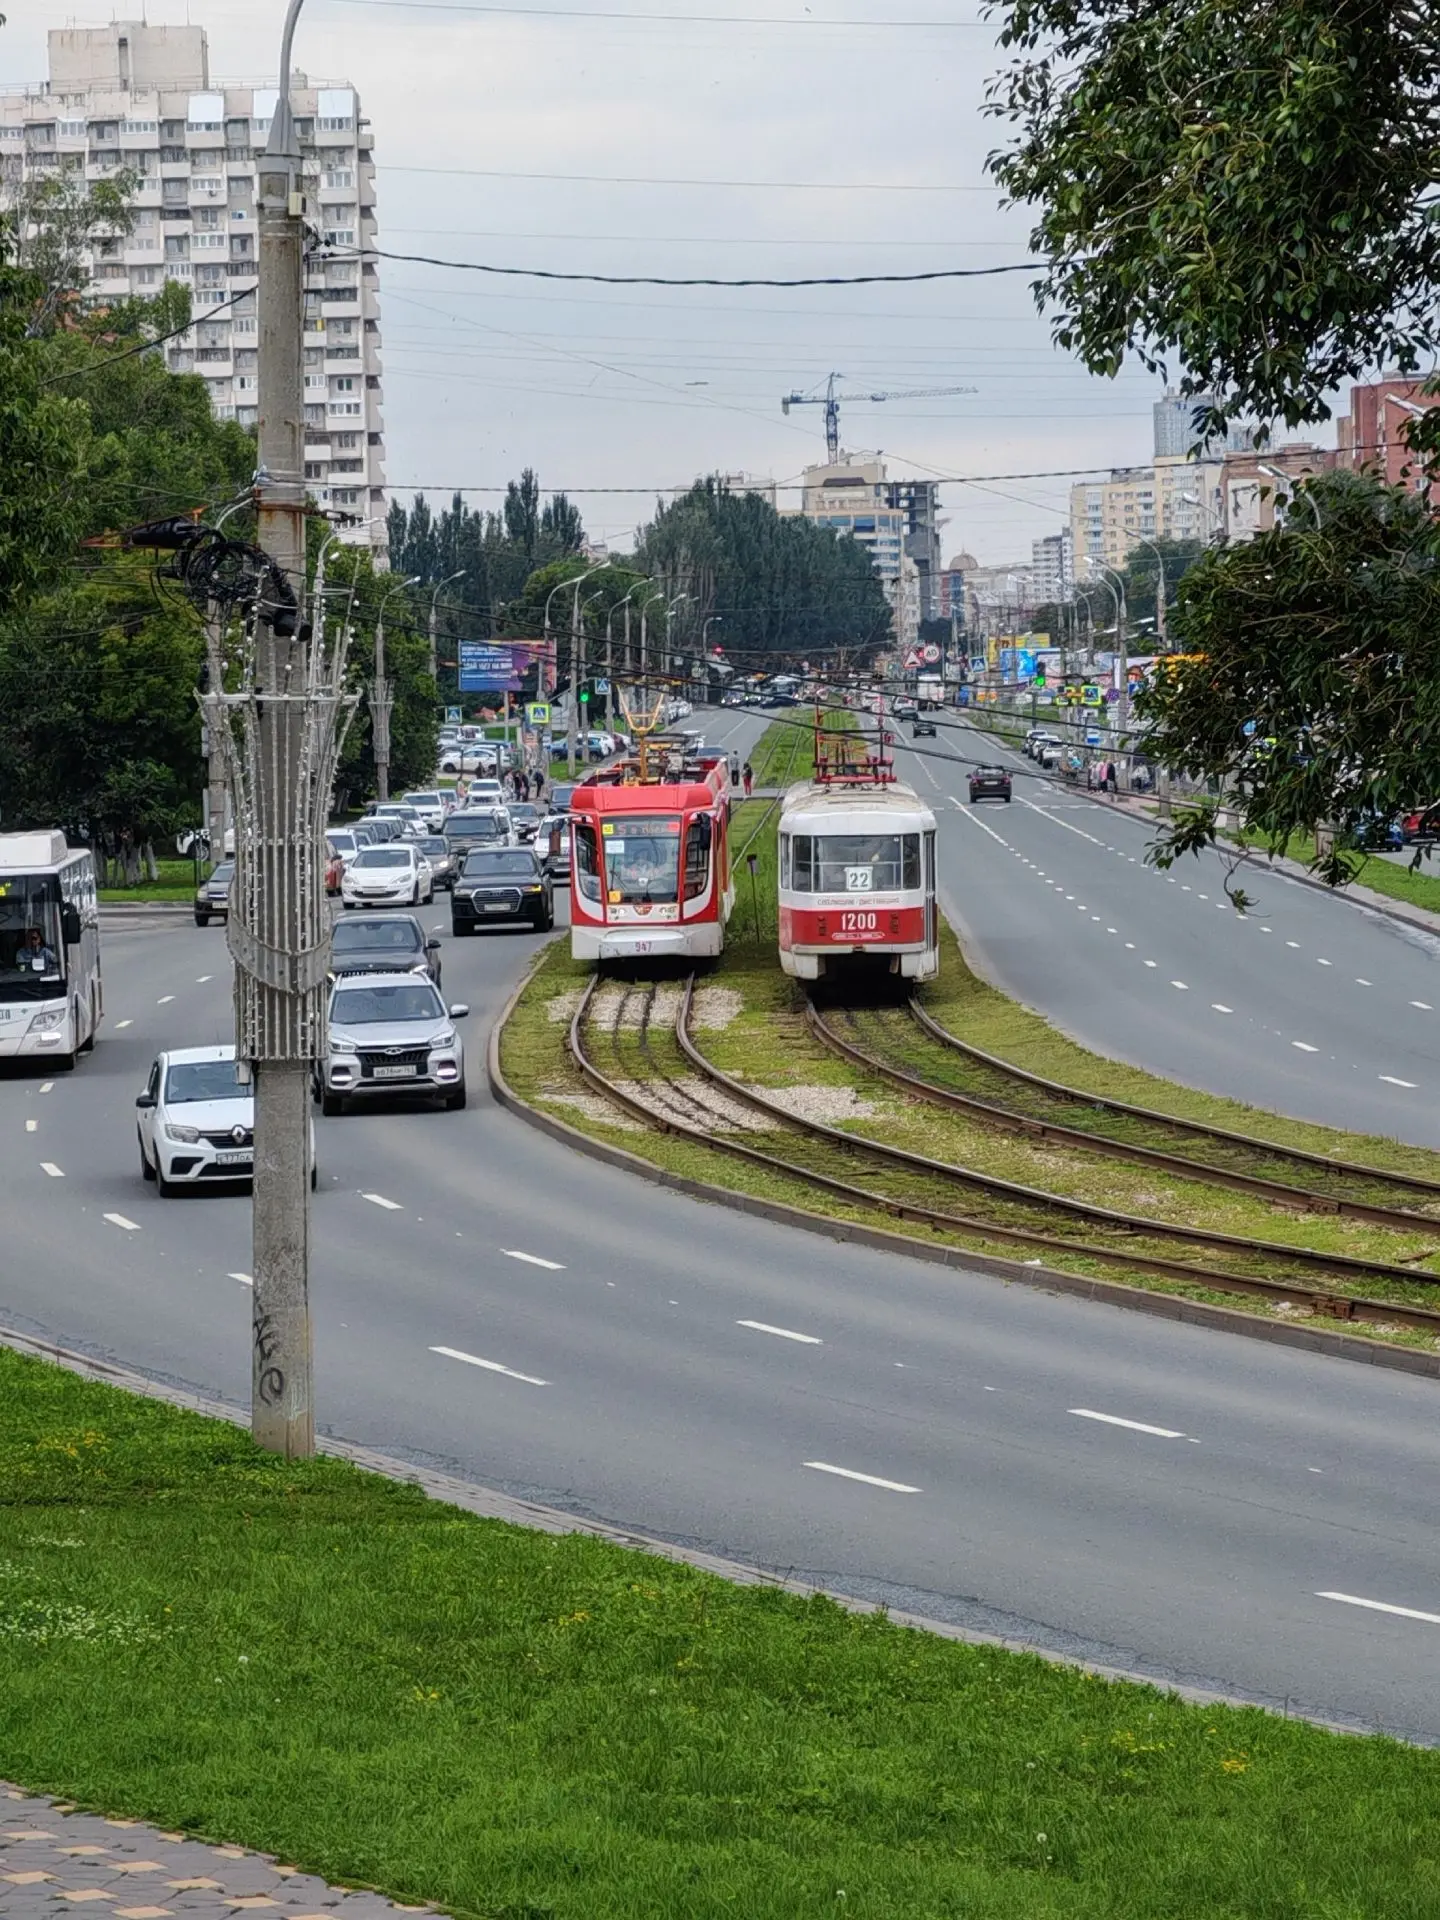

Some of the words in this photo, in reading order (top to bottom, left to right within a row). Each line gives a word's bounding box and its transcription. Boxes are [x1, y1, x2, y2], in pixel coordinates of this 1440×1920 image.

[926, 649, 937, 657] 40
[849, 872, 869, 888] 22
[841, 912, 877, 930] 1200
